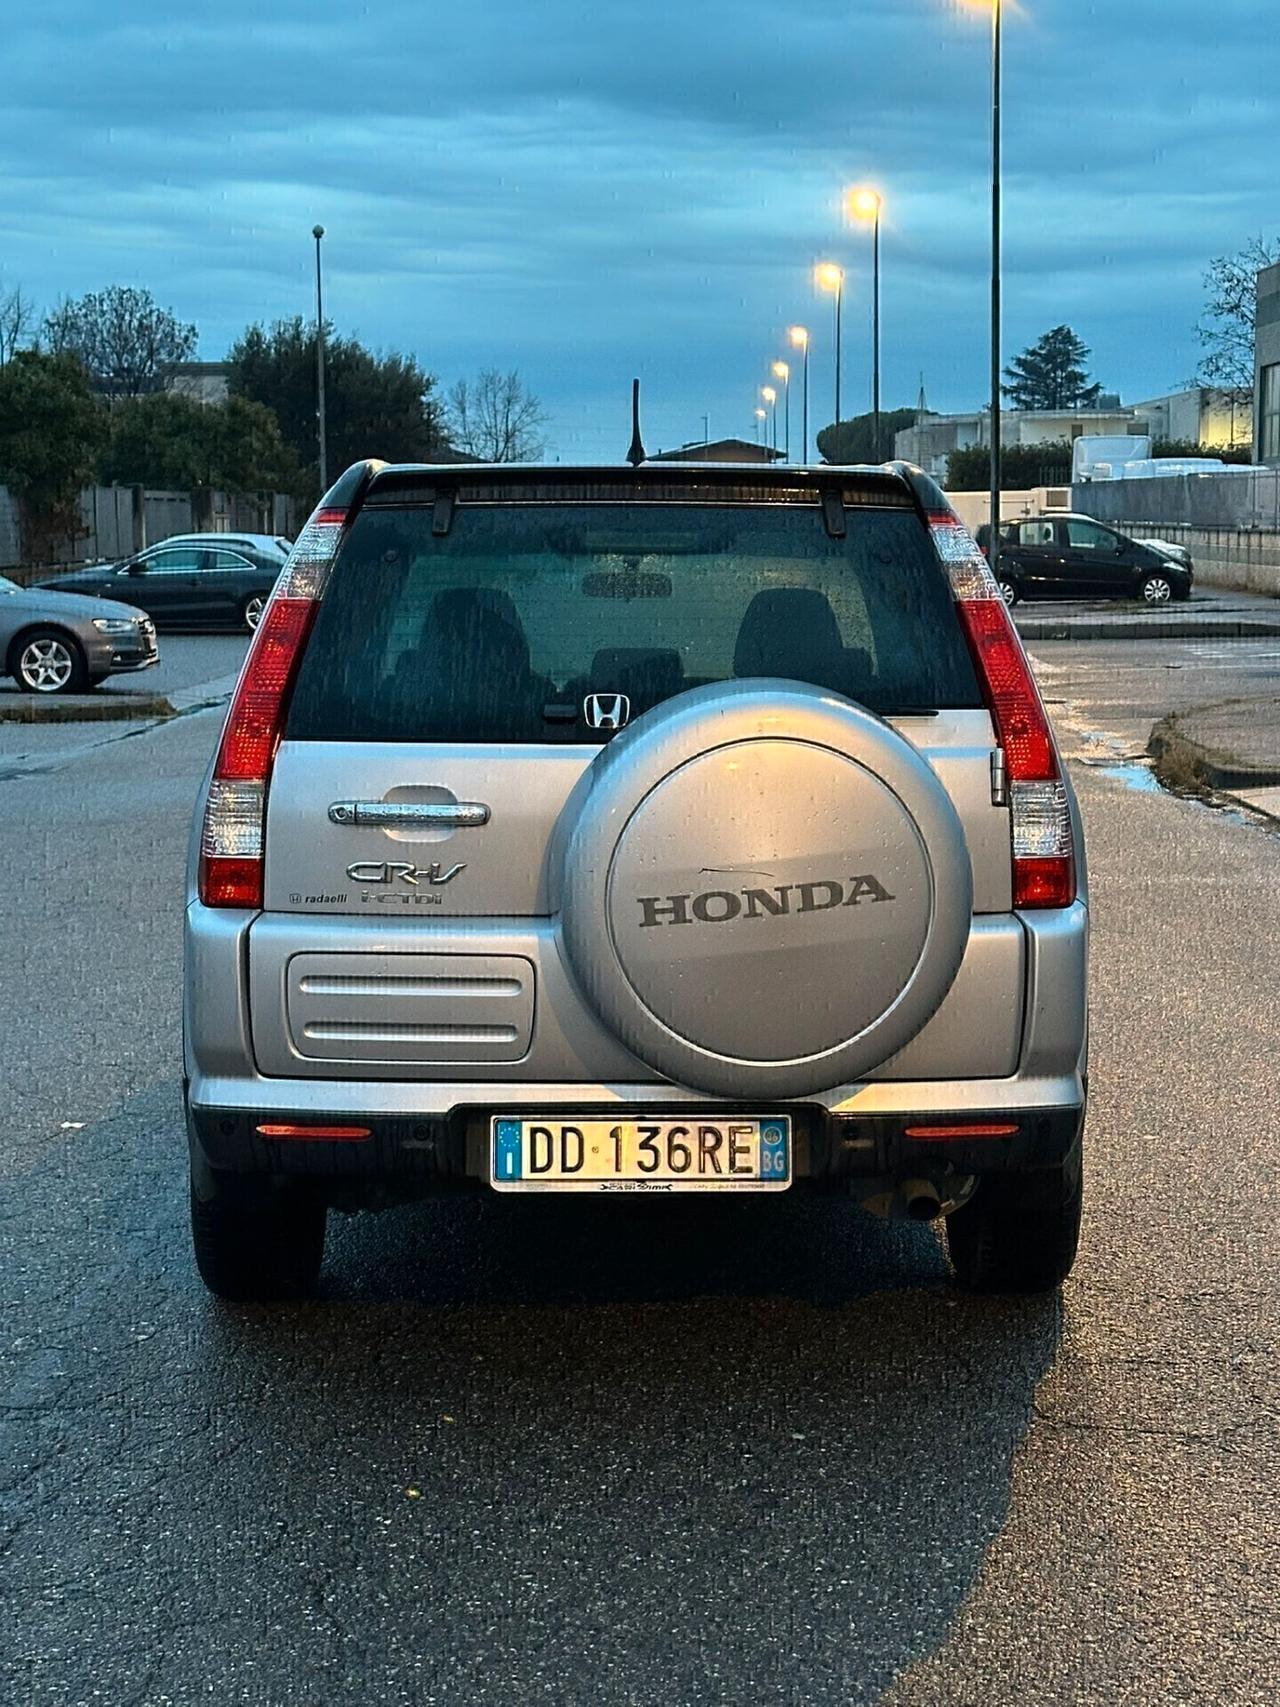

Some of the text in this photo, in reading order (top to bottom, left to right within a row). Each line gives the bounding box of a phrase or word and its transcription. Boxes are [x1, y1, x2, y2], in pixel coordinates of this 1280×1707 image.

[346, 860, 467, 885] CR-V
[304, 894, 348, 904] radaelli
[636, 874, 896, 928] HONDA
[529, 1125, 754, 1174] DD 136RE
[762, 1150, 785, 1172] BG
